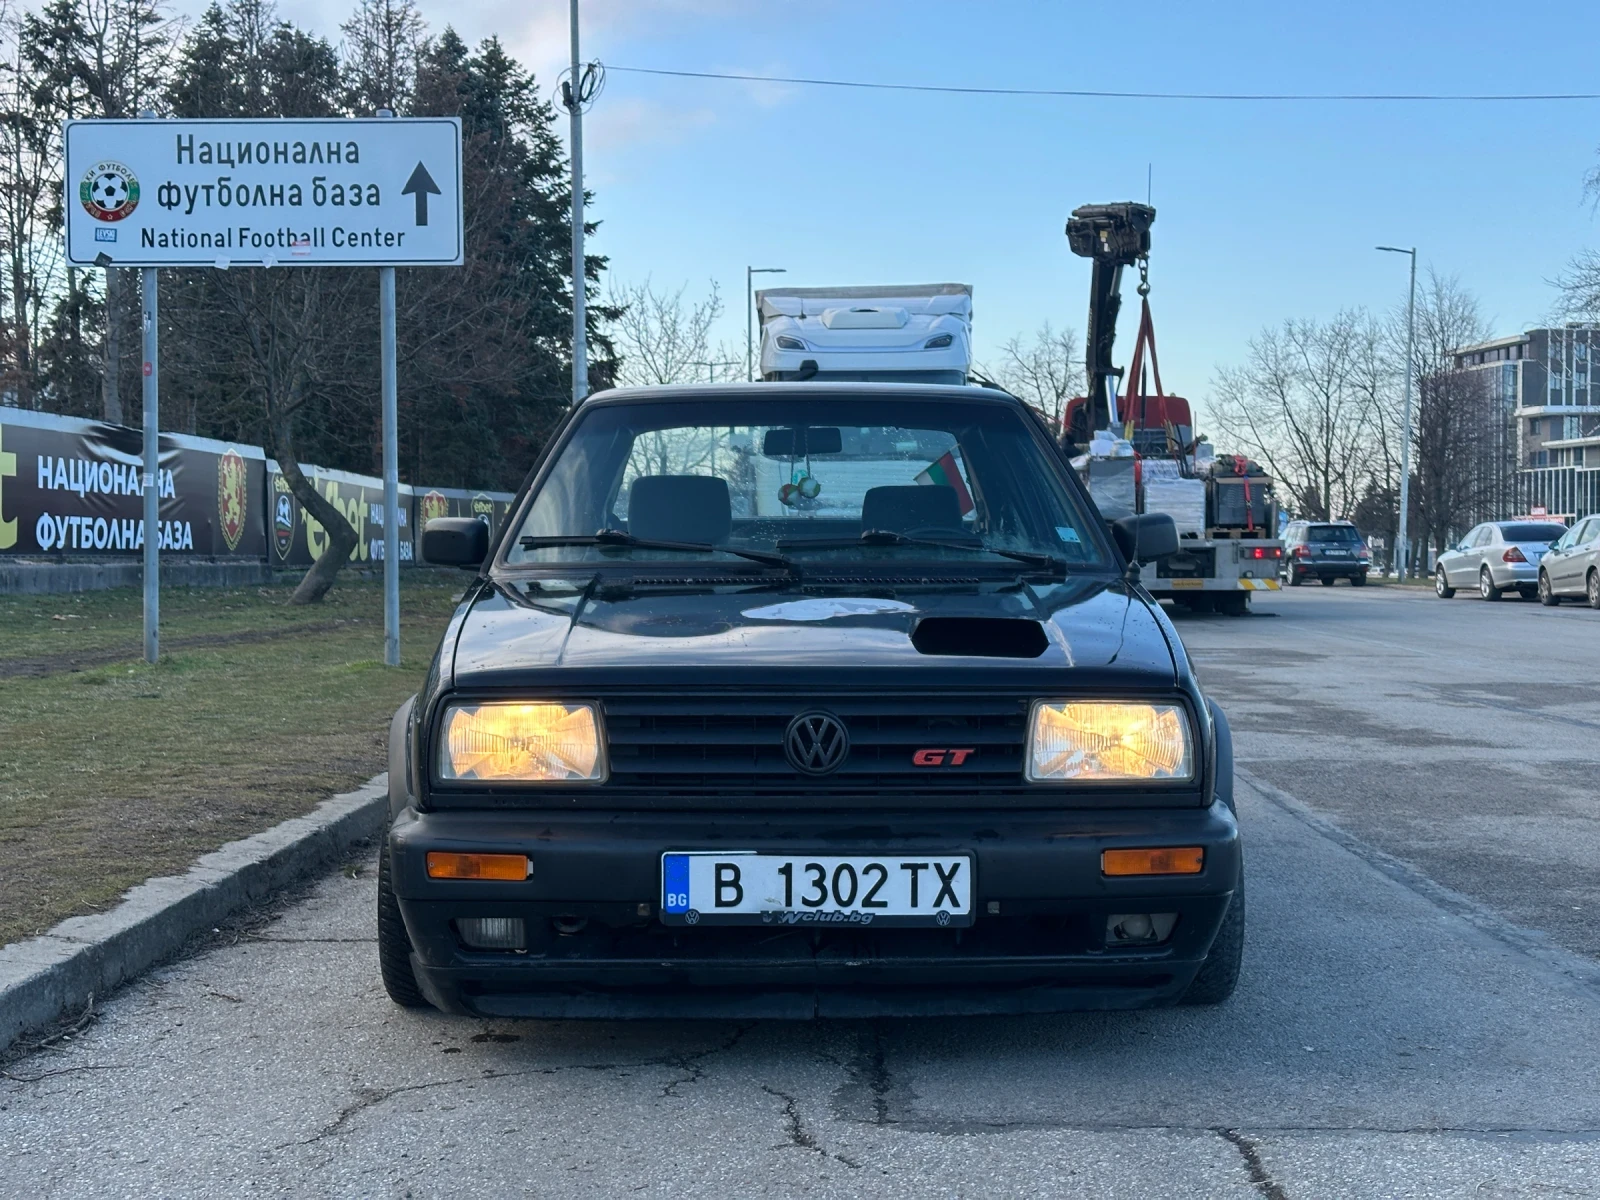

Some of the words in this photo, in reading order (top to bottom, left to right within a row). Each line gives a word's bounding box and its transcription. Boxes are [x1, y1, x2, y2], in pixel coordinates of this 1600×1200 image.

[176, 134, 360, 169] Национална
[157, 176, 303, 215] футболна
[312, 176, 381, 207] база
[141, 227, 233, 248] National
[238, 227, 325, 248] Football
[332, 227, 406, 248] Center
[37, 455, 176, 499] НАЦИОНАА
[912, 748, 976, 767] GT
[667, 893, 688, 907] BG
[714, 862, 744, 907] B
[778, 862, 888, 908] 1302
[900, 862, 962, 908] TX
